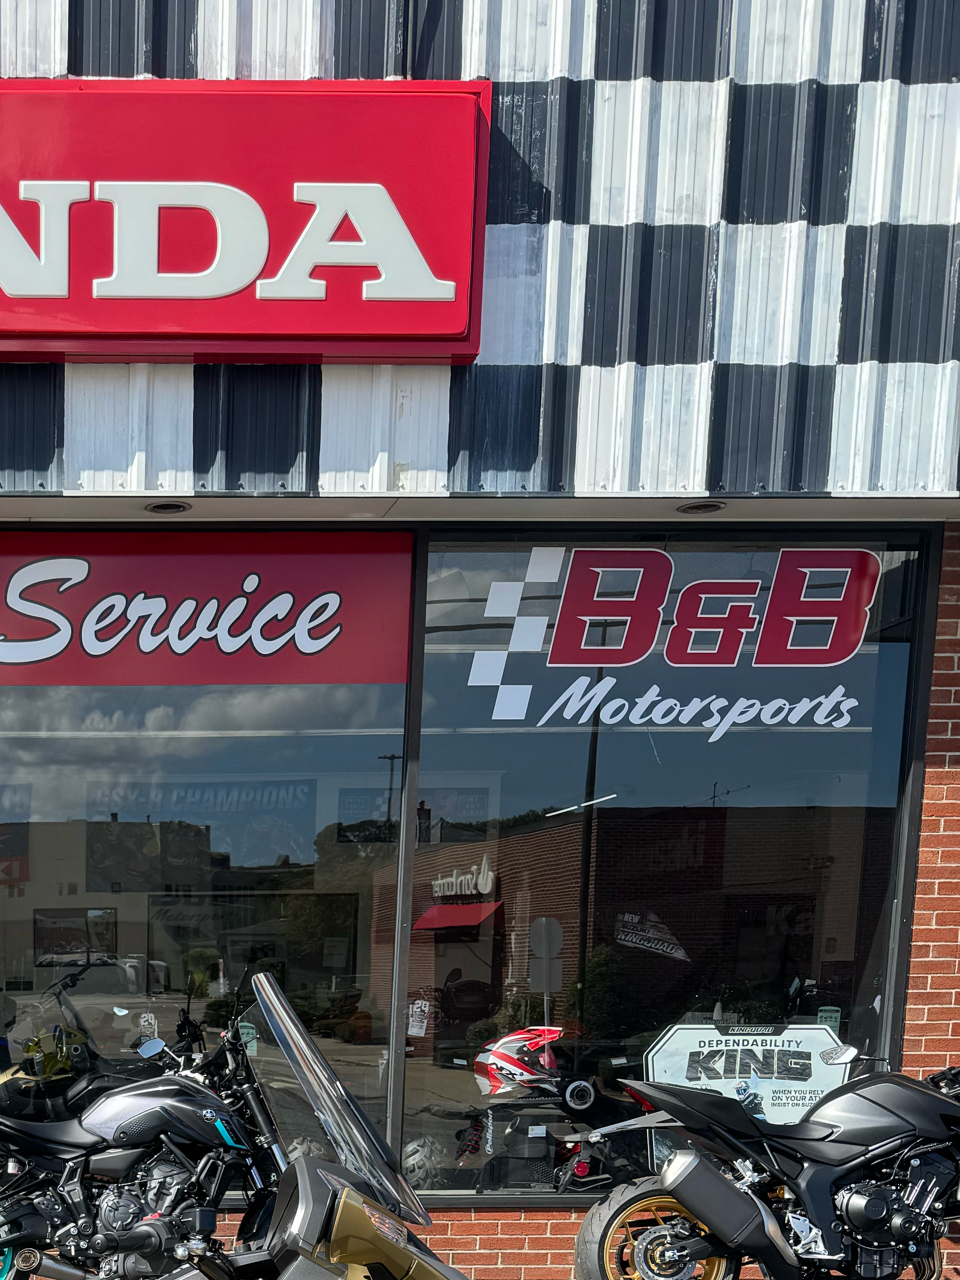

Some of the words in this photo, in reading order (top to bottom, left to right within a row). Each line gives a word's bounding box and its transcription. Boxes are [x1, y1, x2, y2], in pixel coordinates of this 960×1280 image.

[547, 547, 882, 668] B&B
[537, 676, 860, 743] Motorsports
[95, 786, 163, 813] GSX-R
[169, 785, 310, 813] CHAMPIONS
[623, 912, 642, 923] NEW
[617, 930, 678, 955] KINGQUAD
[698, 1039, 803, 1049] DEPENDABILITY
[685, 1048, 812, 1082] KING
